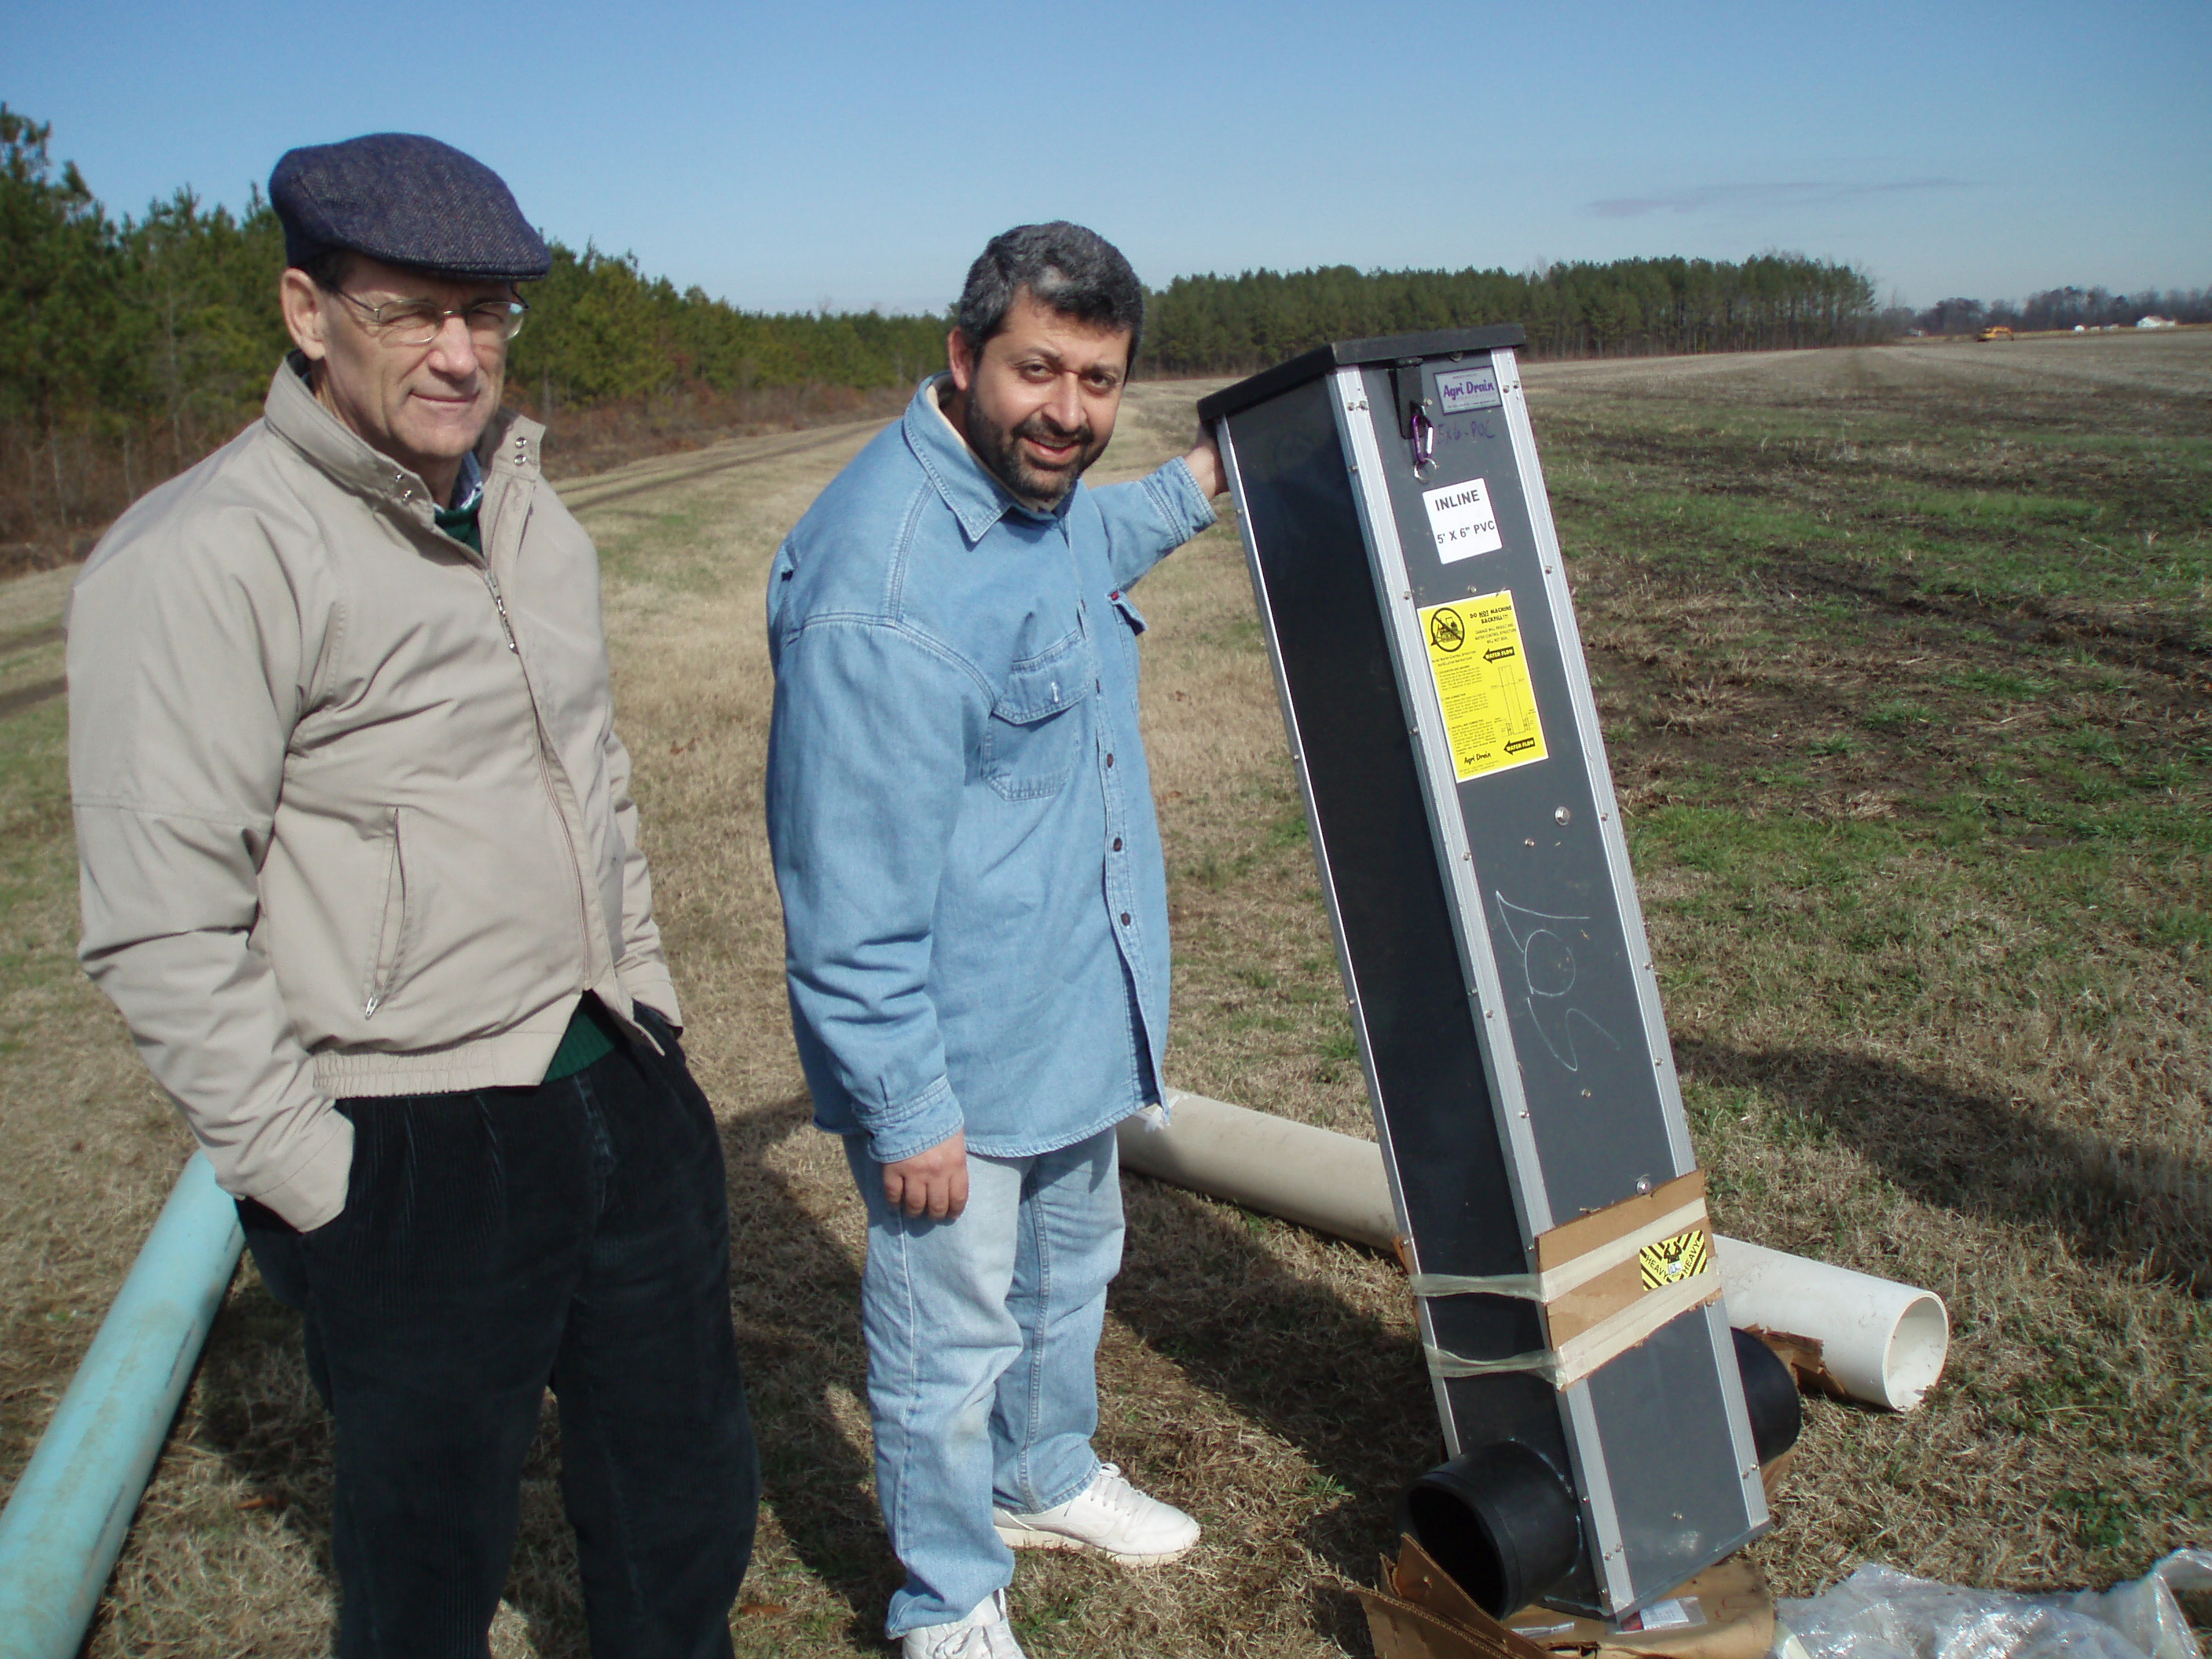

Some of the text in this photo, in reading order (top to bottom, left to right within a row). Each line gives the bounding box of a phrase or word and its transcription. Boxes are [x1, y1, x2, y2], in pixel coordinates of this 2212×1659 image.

[1443, 383, 1464, 401] Agri
[1466, 379, 1495, 394] Drain
[1434, 489, 1481, 511] INLINE
[1437, 520, 1495, 544] 5' X 6" PVC
[1645, 1254, 1668, 1279] HEAVY
[1683, 1240, 1700, 1274] HEAVY
